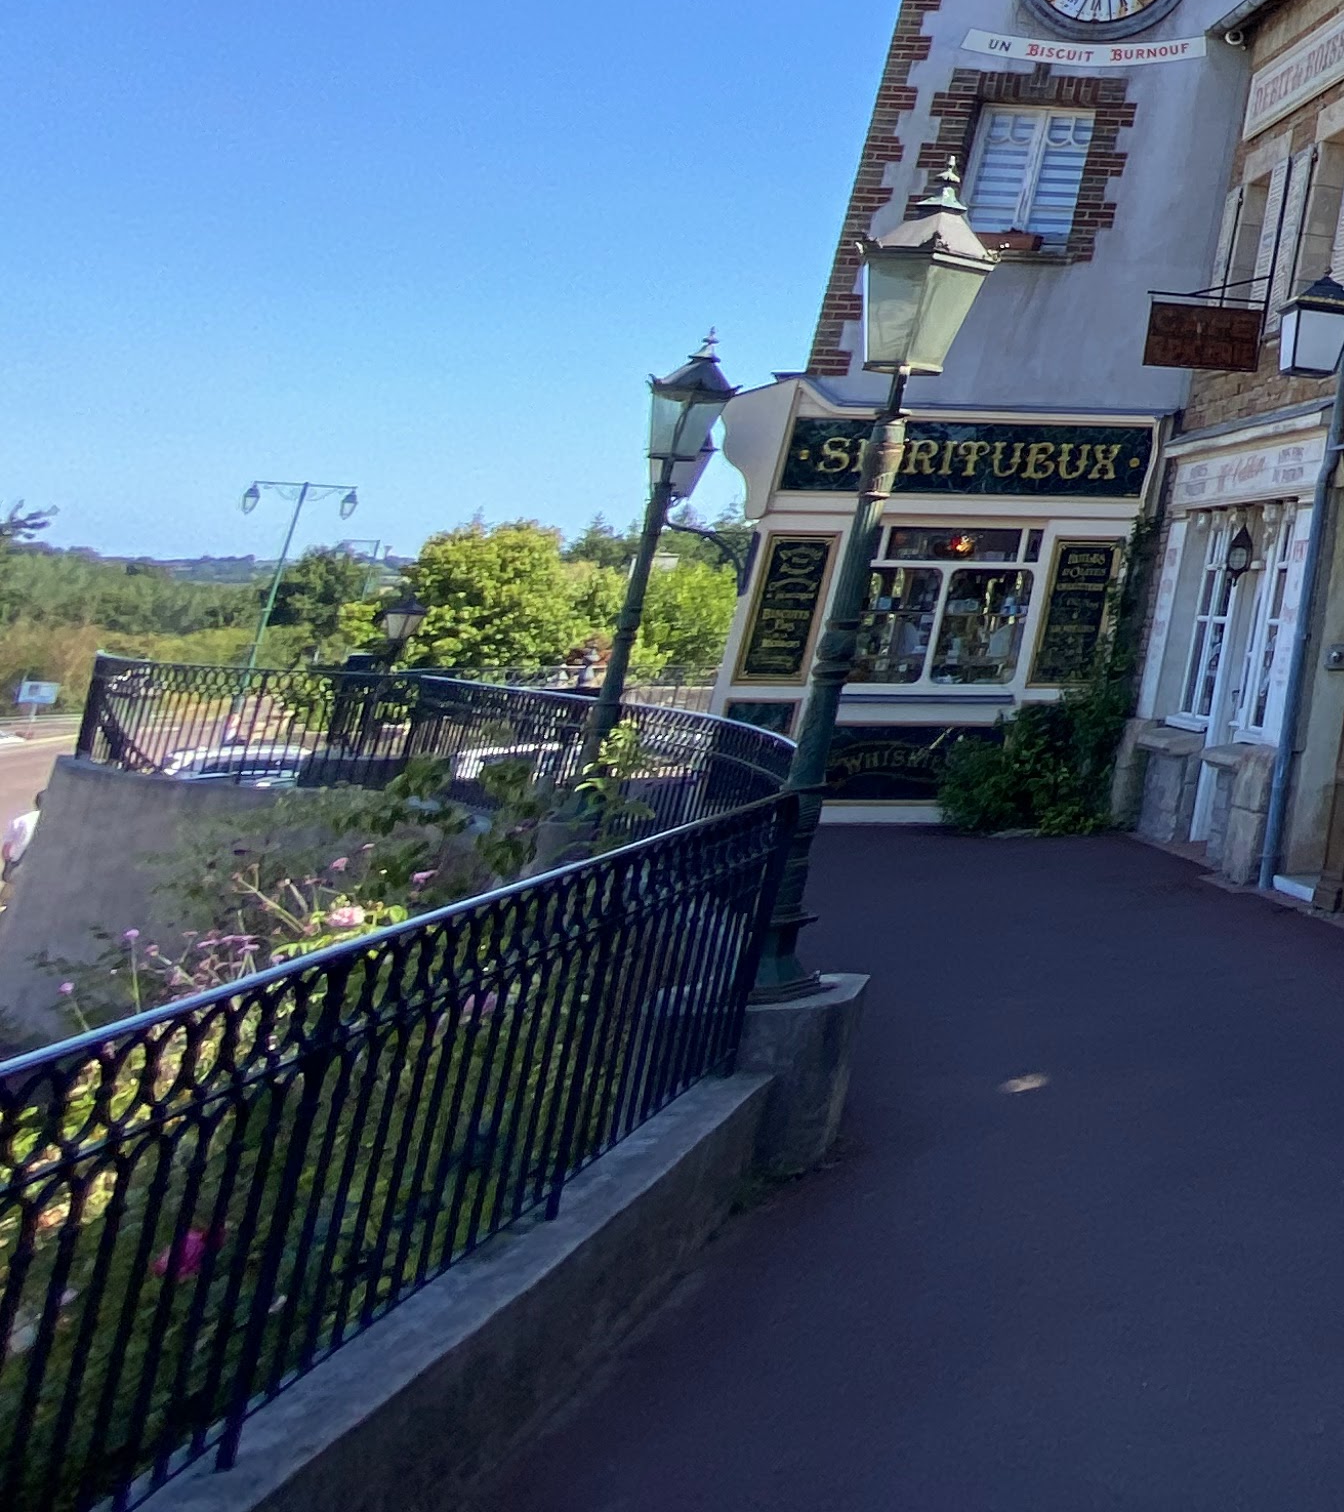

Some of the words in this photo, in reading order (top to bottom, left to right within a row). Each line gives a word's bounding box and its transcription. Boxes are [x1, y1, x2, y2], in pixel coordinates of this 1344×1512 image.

[988, 38, 1012, 52] UN
[1025, 42, 1095, 61] BISCUIT
[1110, 42, 1190, 61] BURNOUF
